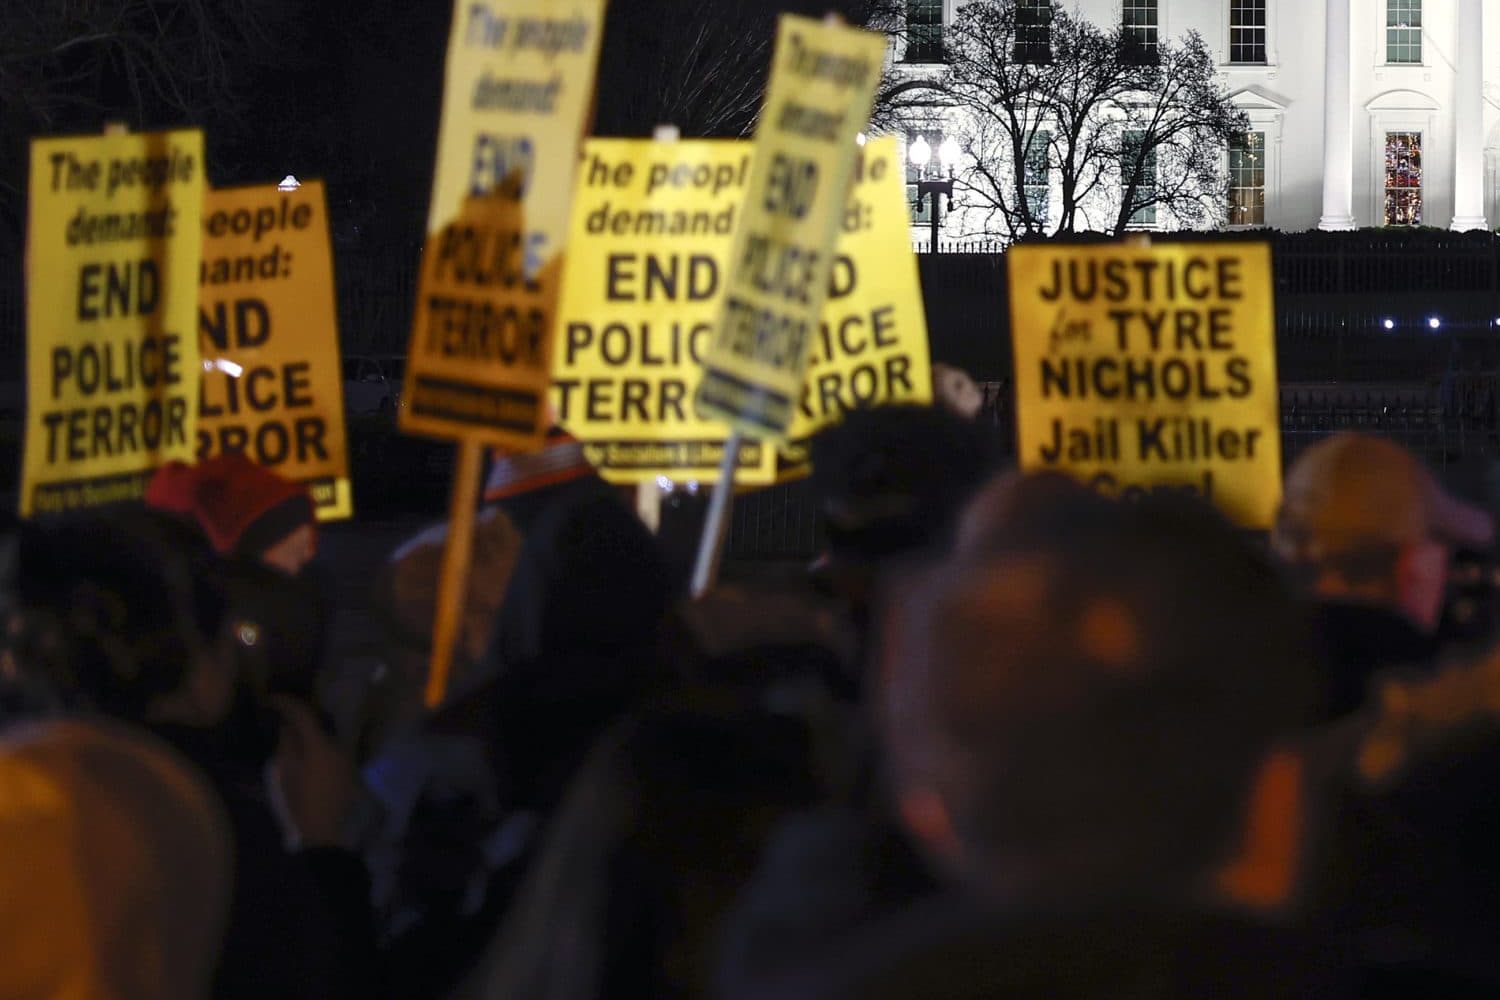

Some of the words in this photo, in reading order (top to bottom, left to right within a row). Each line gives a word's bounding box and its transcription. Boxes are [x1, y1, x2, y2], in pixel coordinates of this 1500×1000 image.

[49, 151, 101, 192] The
[106, 147, 194, 198] people
[579, 152, 635, 190] he
[646, 154, 749, 196] peopl
[204, 197, 314, 241] eople
[199, 244, 293, 286] and:
[605, 253, 720, 302] END
[1039, 257, 1243, 303] JUSTICE
[76, 258, 161, 322] END
[197, 298, 271, 350] ND
[565, 322, 712, 367] POLIC
[810, 305, 899, 364] ICE
[1049, 308, 1093, 352] for
[1107, 307, 1235, 351] TYRE
[52, 333, 182, 399] POLICE
[198, 362, 315, 417] LICE
[1039, 357, 1253, 400] NICHOLS
[550, 378, 700, 422] TERR
[42, 396, 189, 465] TERROR
[196, 416, 330, 467] ROR
[1039, 417, 1120, 464] Jail
[1137, 416, 1262, 462] Killer
